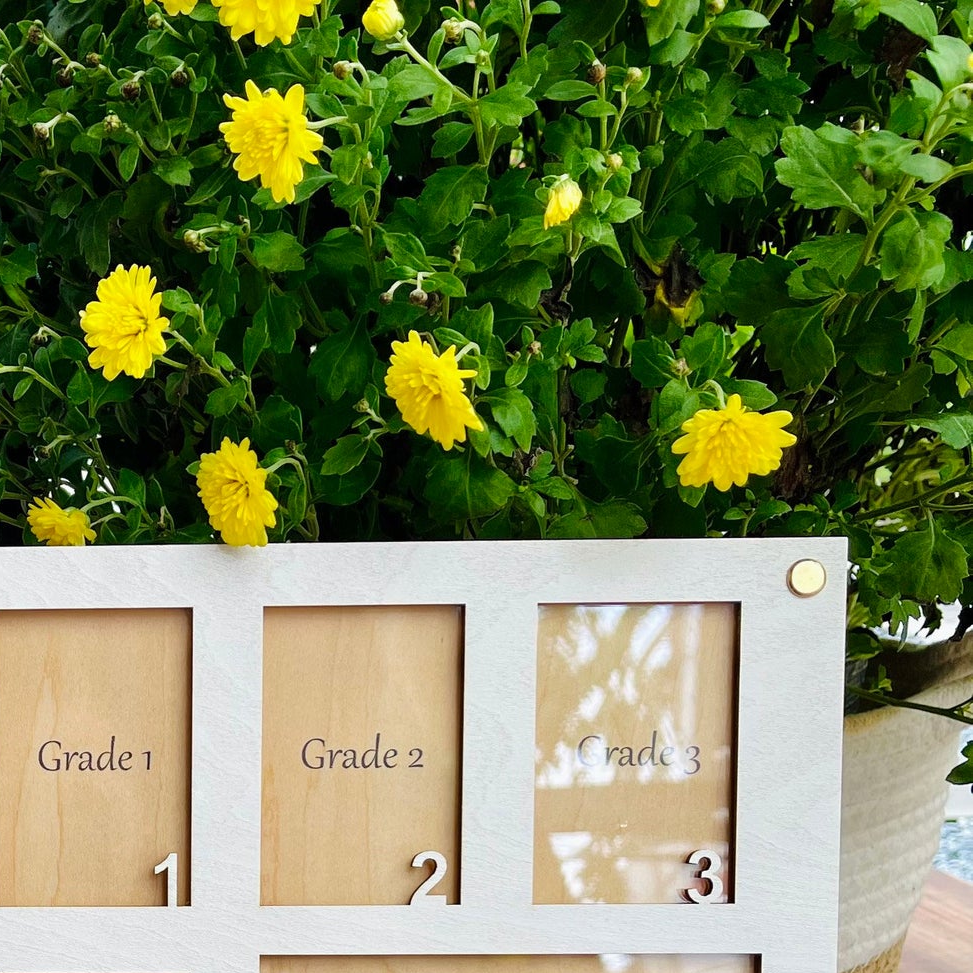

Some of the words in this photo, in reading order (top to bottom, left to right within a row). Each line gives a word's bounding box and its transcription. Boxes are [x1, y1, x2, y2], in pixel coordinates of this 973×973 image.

[38, 736, 133, 772] Grade
[142, 751, 152, 771] 1
[301, 732, 398, 770] Grade
[409, 748, 424, 769] 2
[577, 731, 675, 769] Grade
[685, 744, 702, 775] 3
[153, 853, 178, 907] 1
[410, 851, 448, 905] 2
[687, 850, 723, 904] 3
